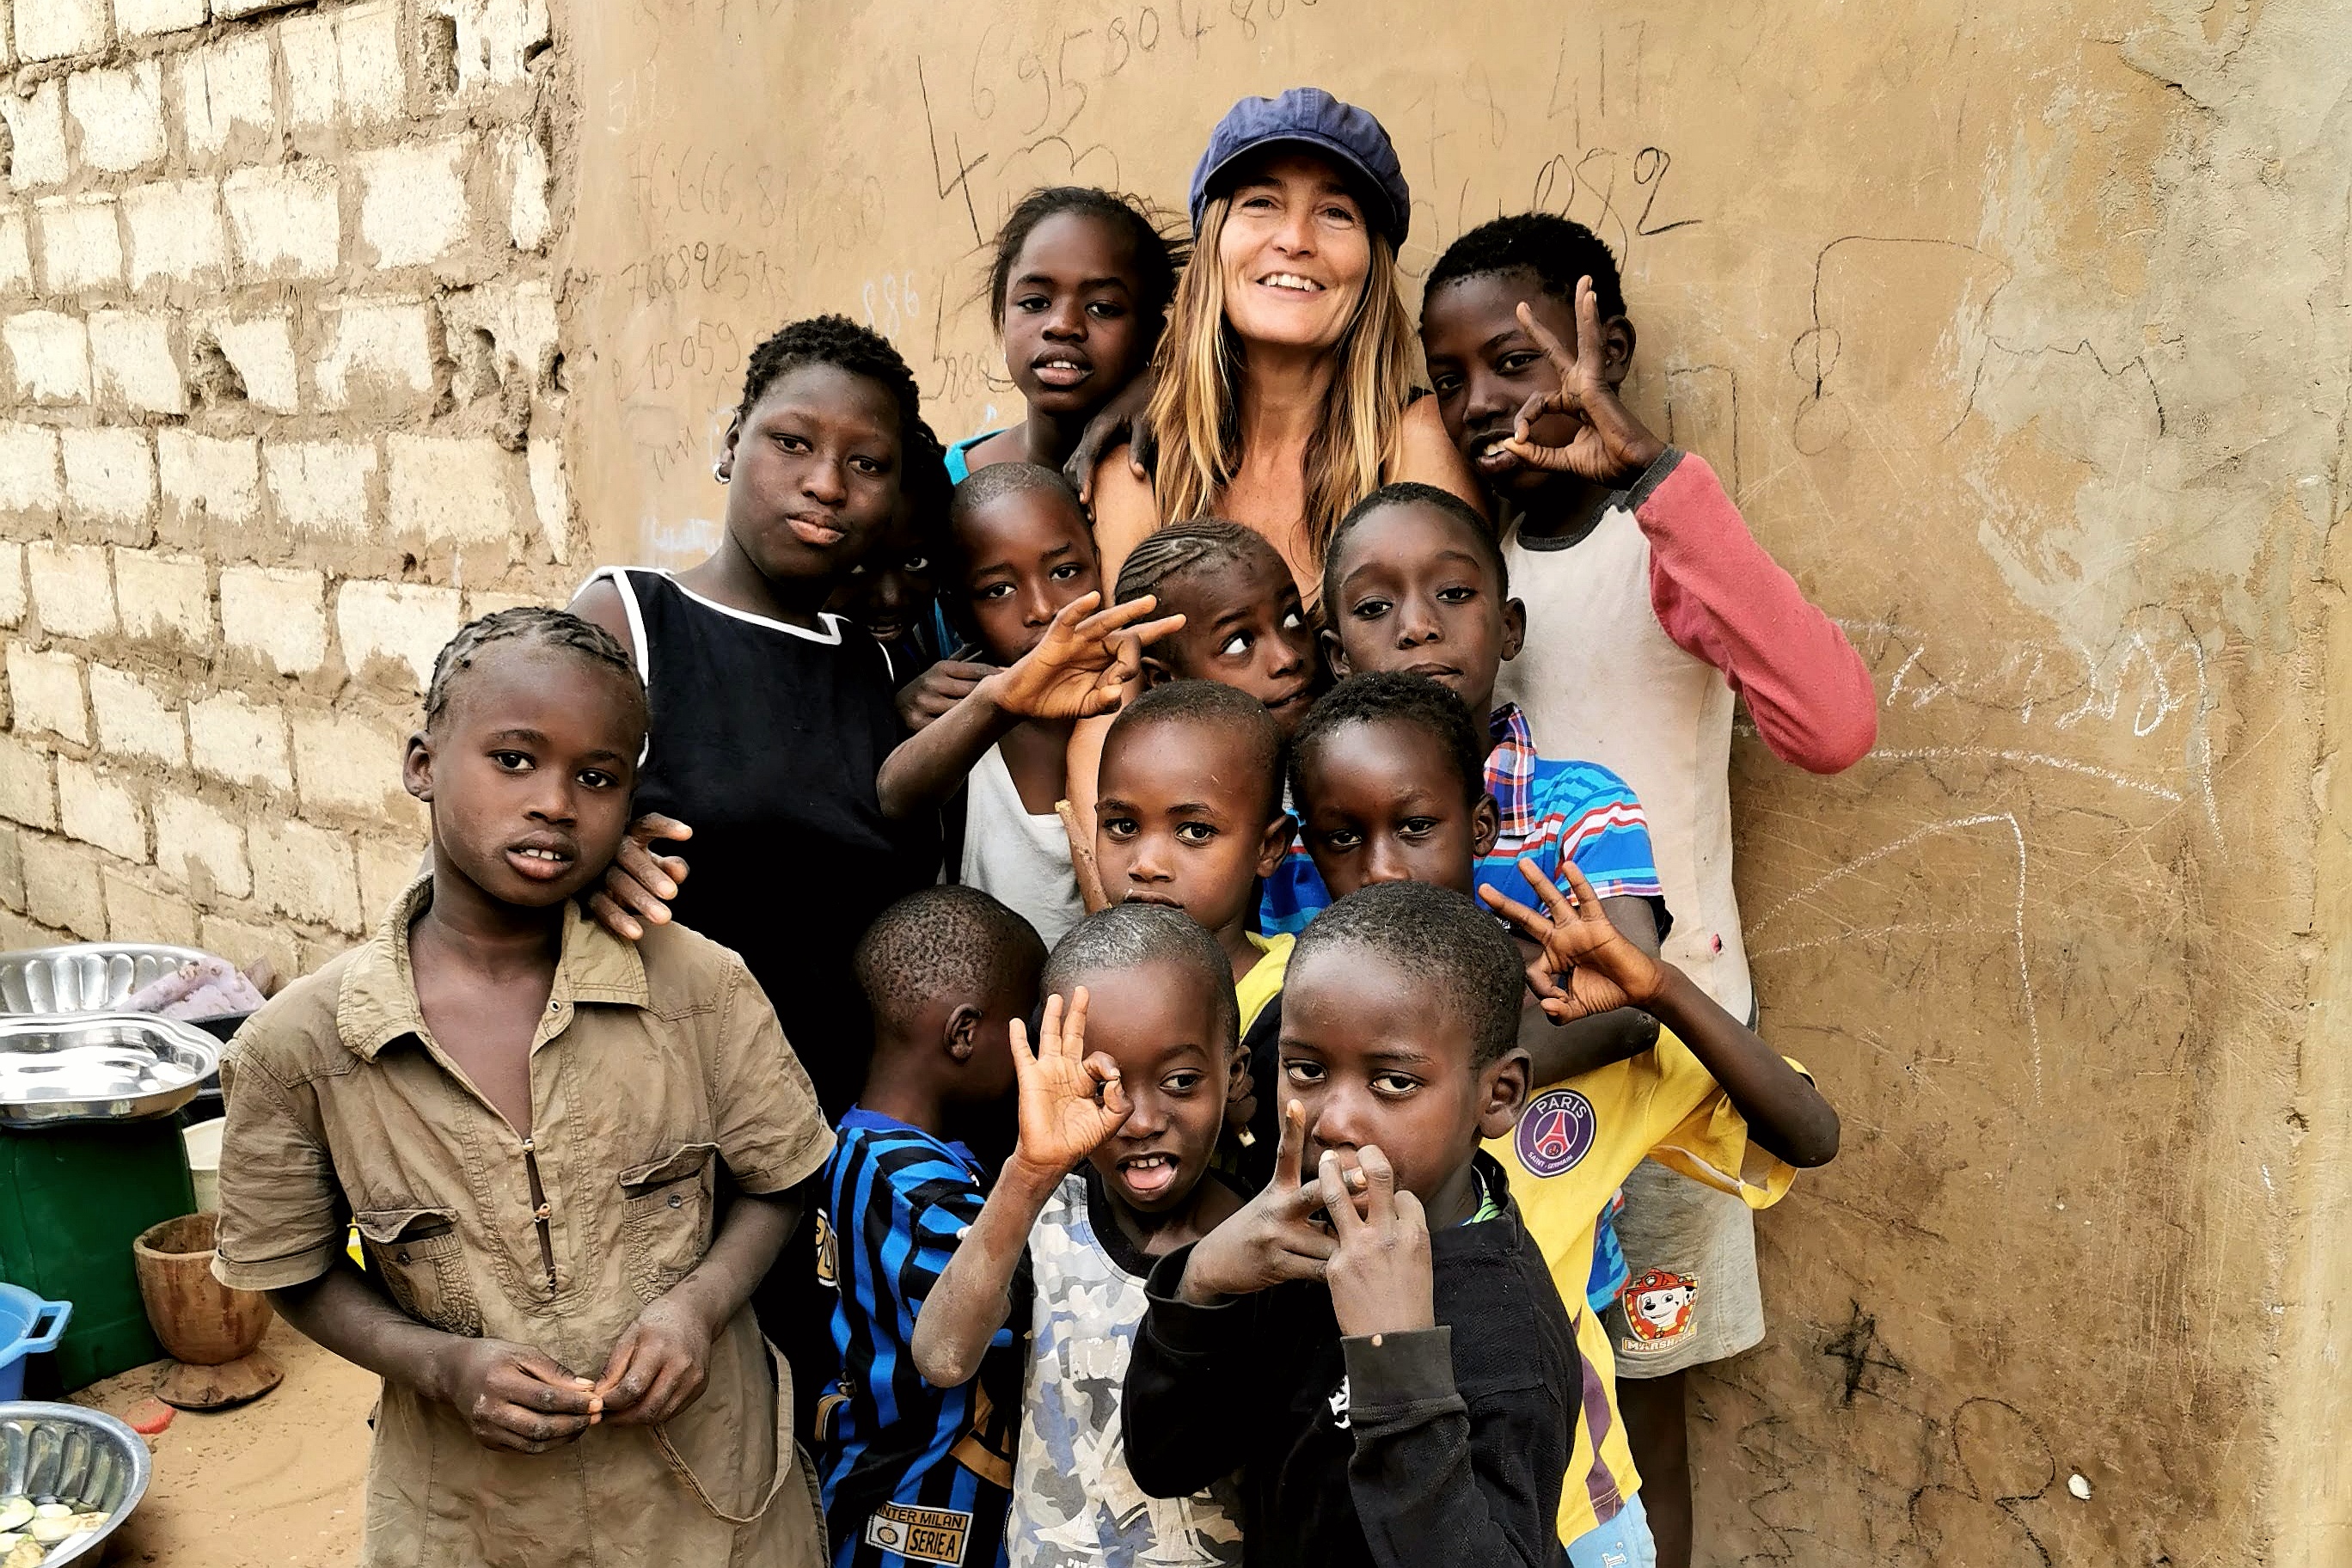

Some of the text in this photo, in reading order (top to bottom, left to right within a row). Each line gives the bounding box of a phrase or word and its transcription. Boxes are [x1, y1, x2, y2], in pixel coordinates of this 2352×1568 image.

[1535, 1096, 1587, 1118] PARIS
[919, 1512, 963, 1528] MILAN
[909, 1528, 957, 1558] SERIE A
